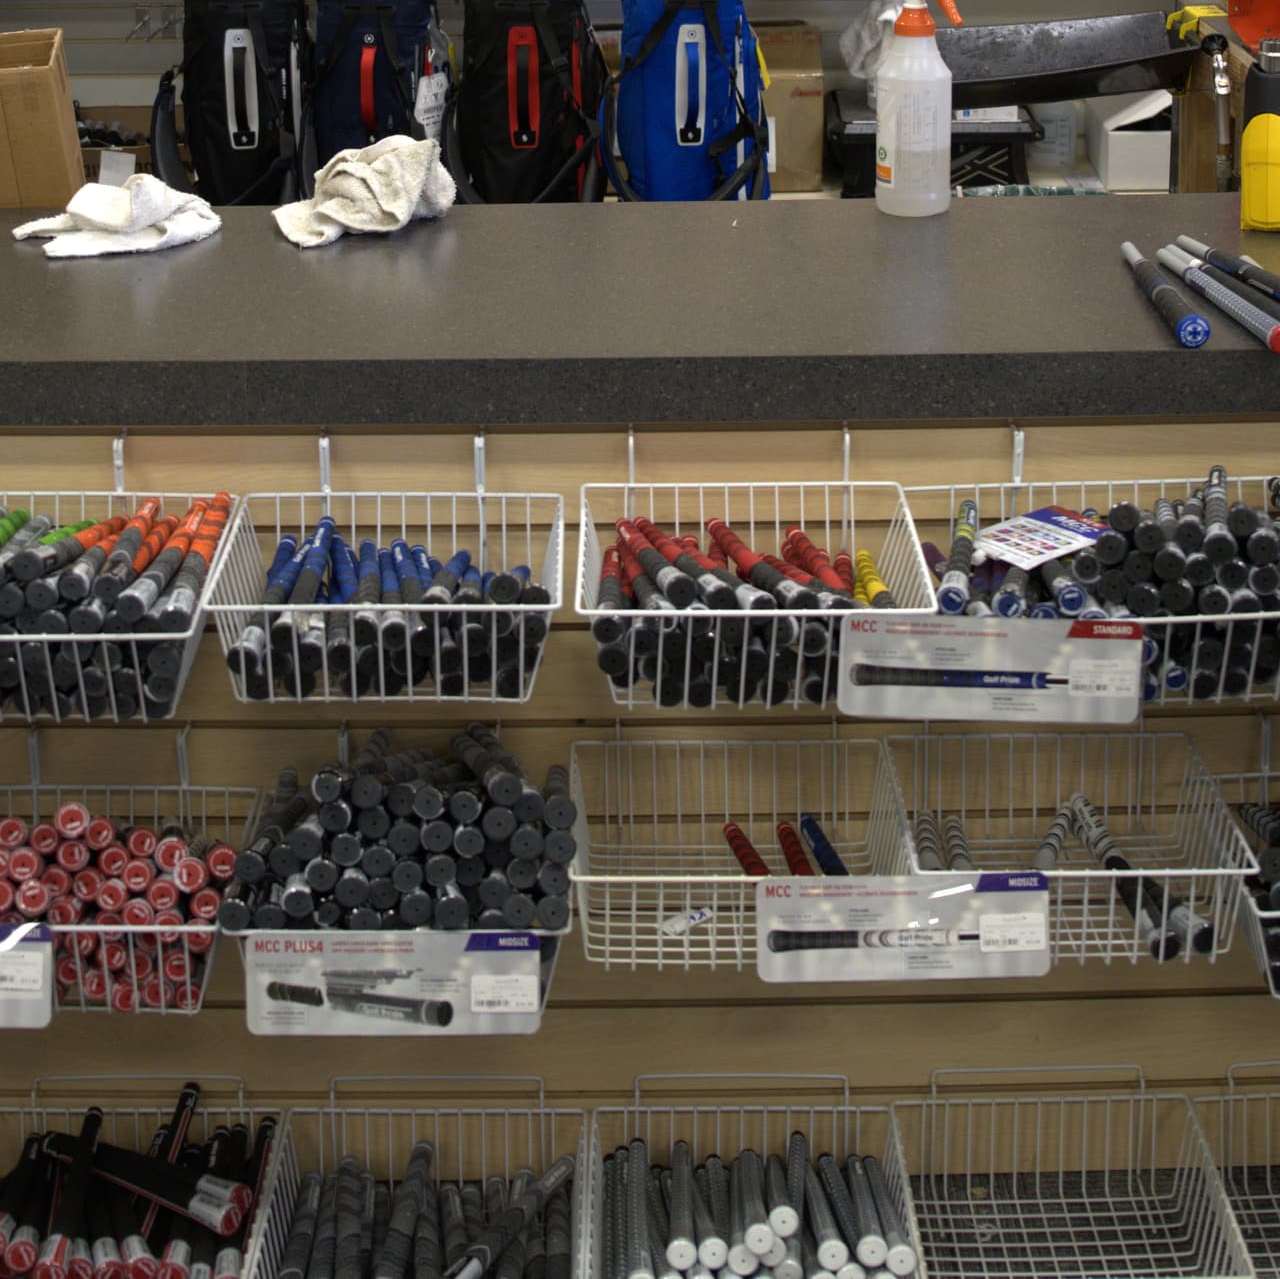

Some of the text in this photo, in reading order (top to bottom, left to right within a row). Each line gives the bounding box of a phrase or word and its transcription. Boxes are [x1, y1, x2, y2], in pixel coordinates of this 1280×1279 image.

[851, 620, 878, 633] MCC
[1092, 624, 1133, 635] STANDARD
[765, 885, 791, 898] MCC
[1008, 877, 1039, 887] MIDSIZE
[255, 940, 280, 953] MCC
[284, 940, 324, 954] PLUS4
[498, 936, 530, 947] MIDSIZE
